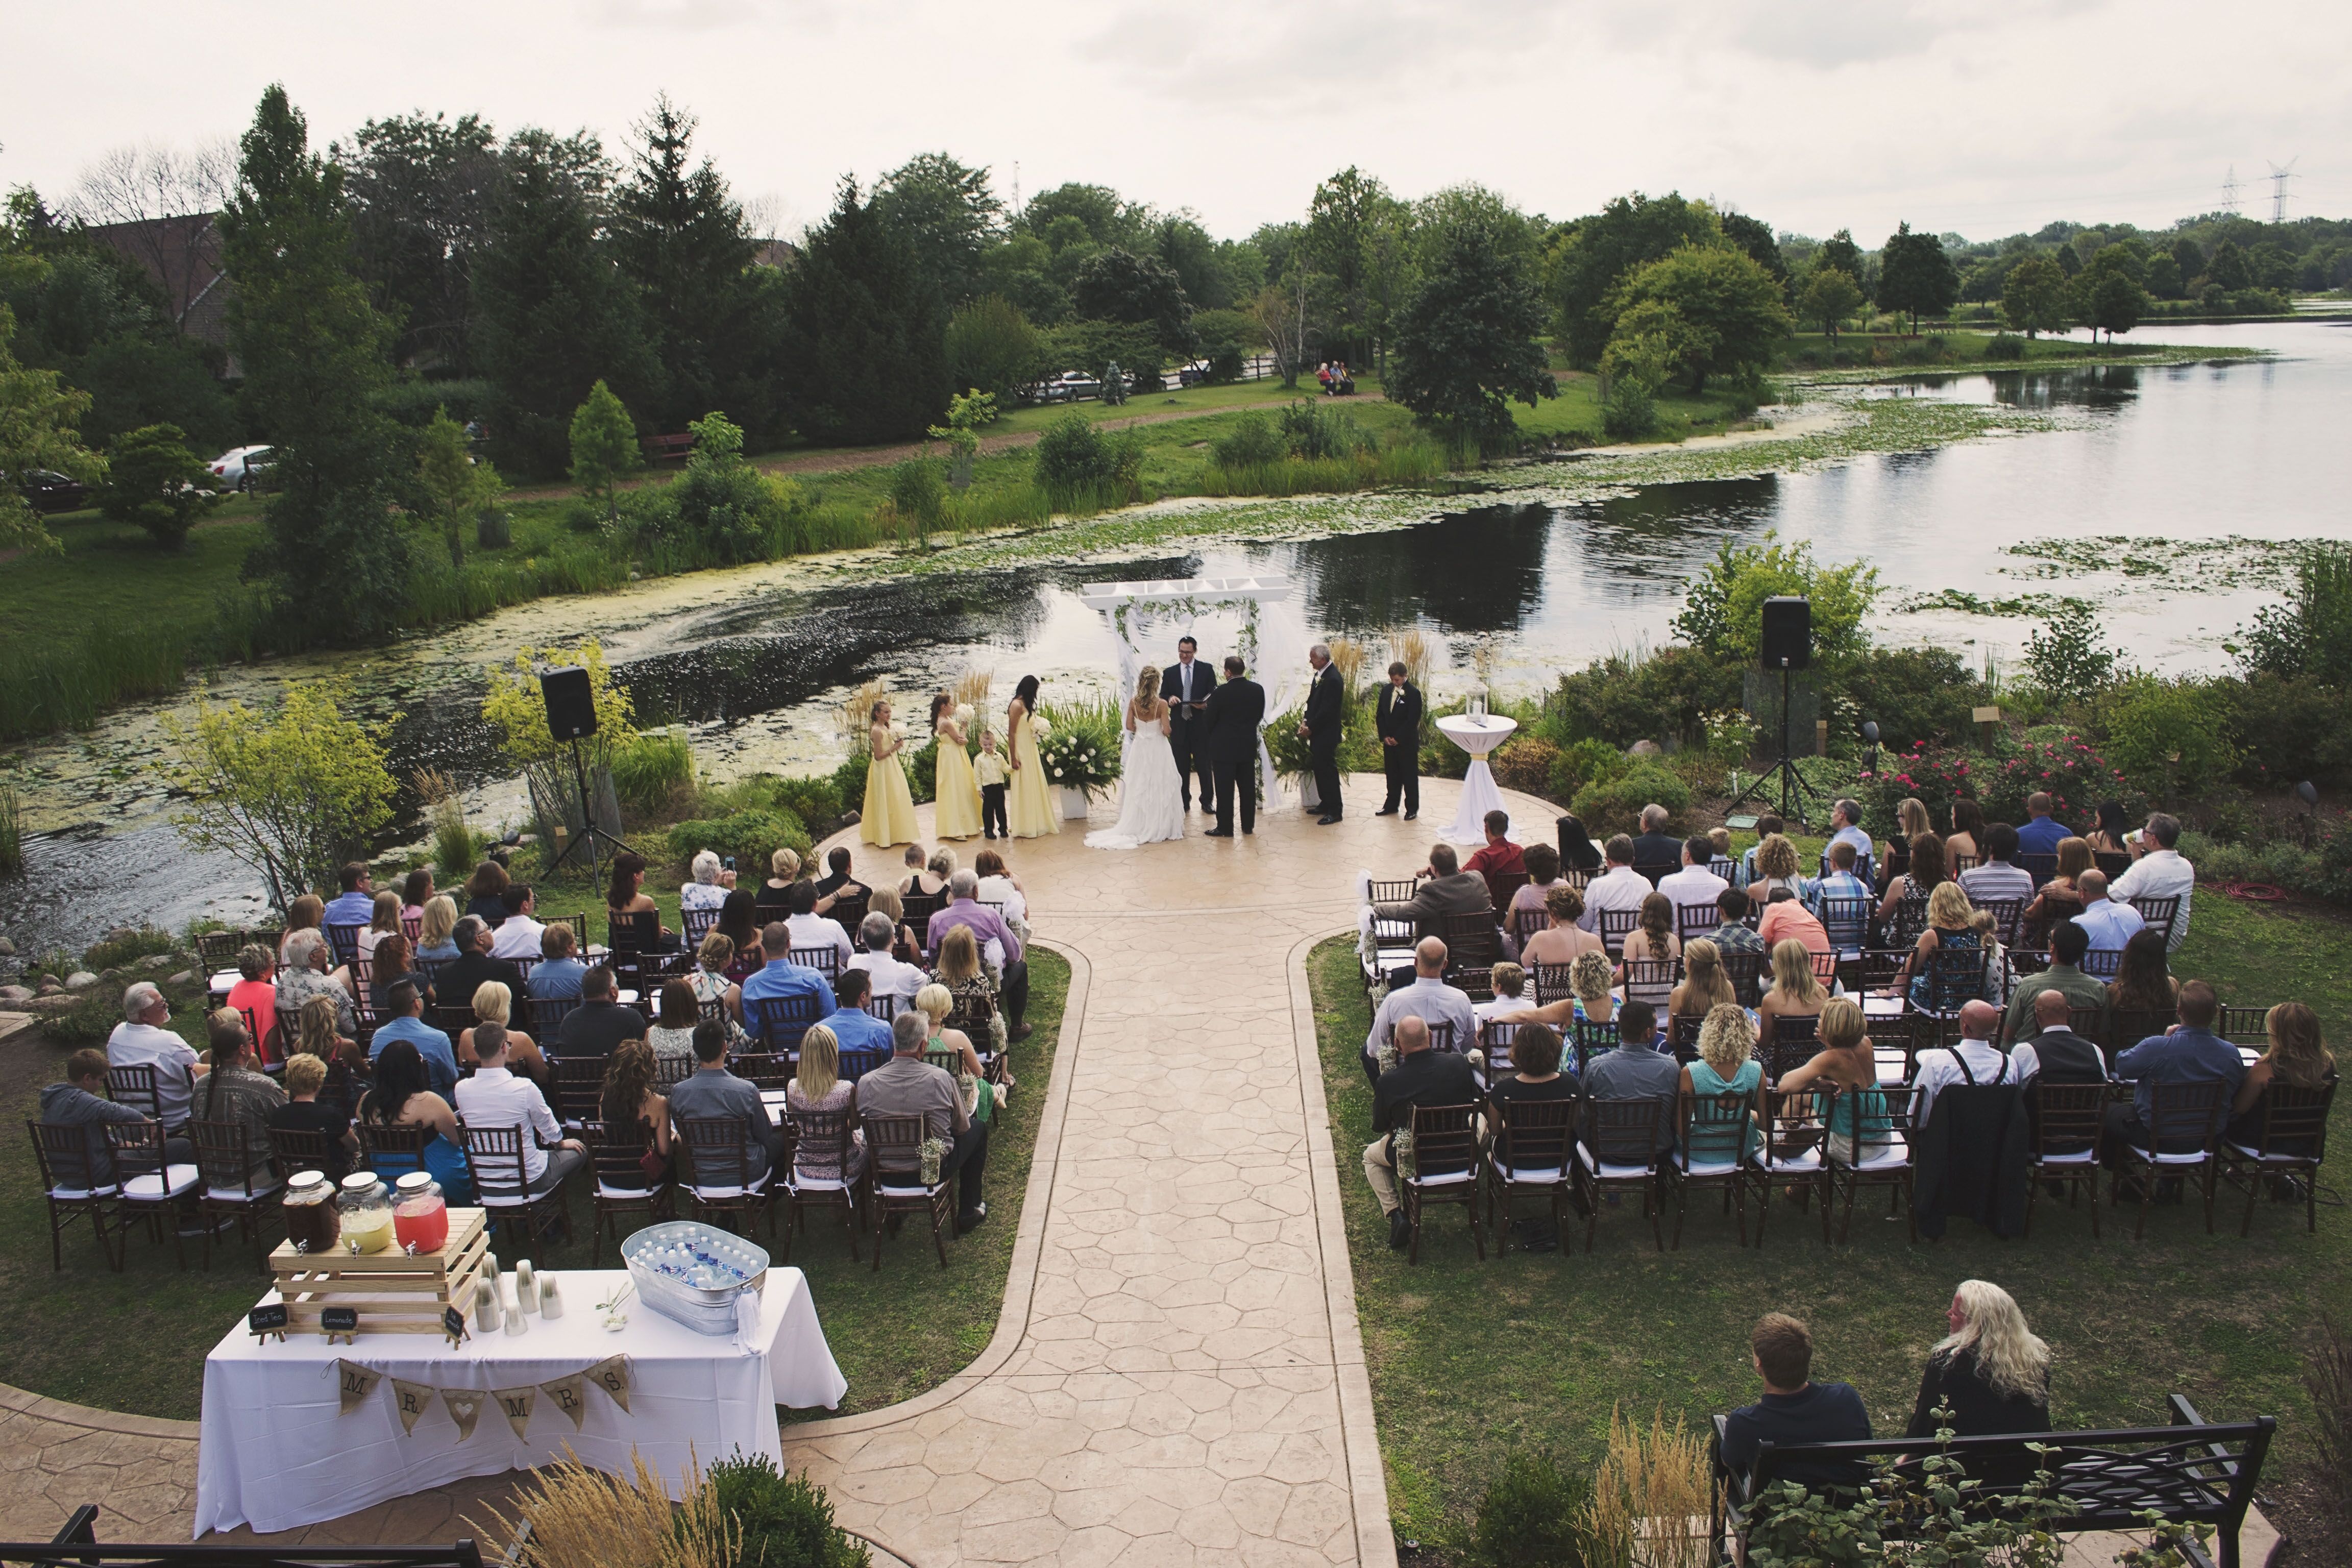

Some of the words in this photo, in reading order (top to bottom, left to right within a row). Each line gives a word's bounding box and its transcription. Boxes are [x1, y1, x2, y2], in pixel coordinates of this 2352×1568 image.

[253, 1313, 268, 1324] Iced
[268, 1312, 282, 1320] Tea
[325, 1314, 353, 1324] Lemonade
